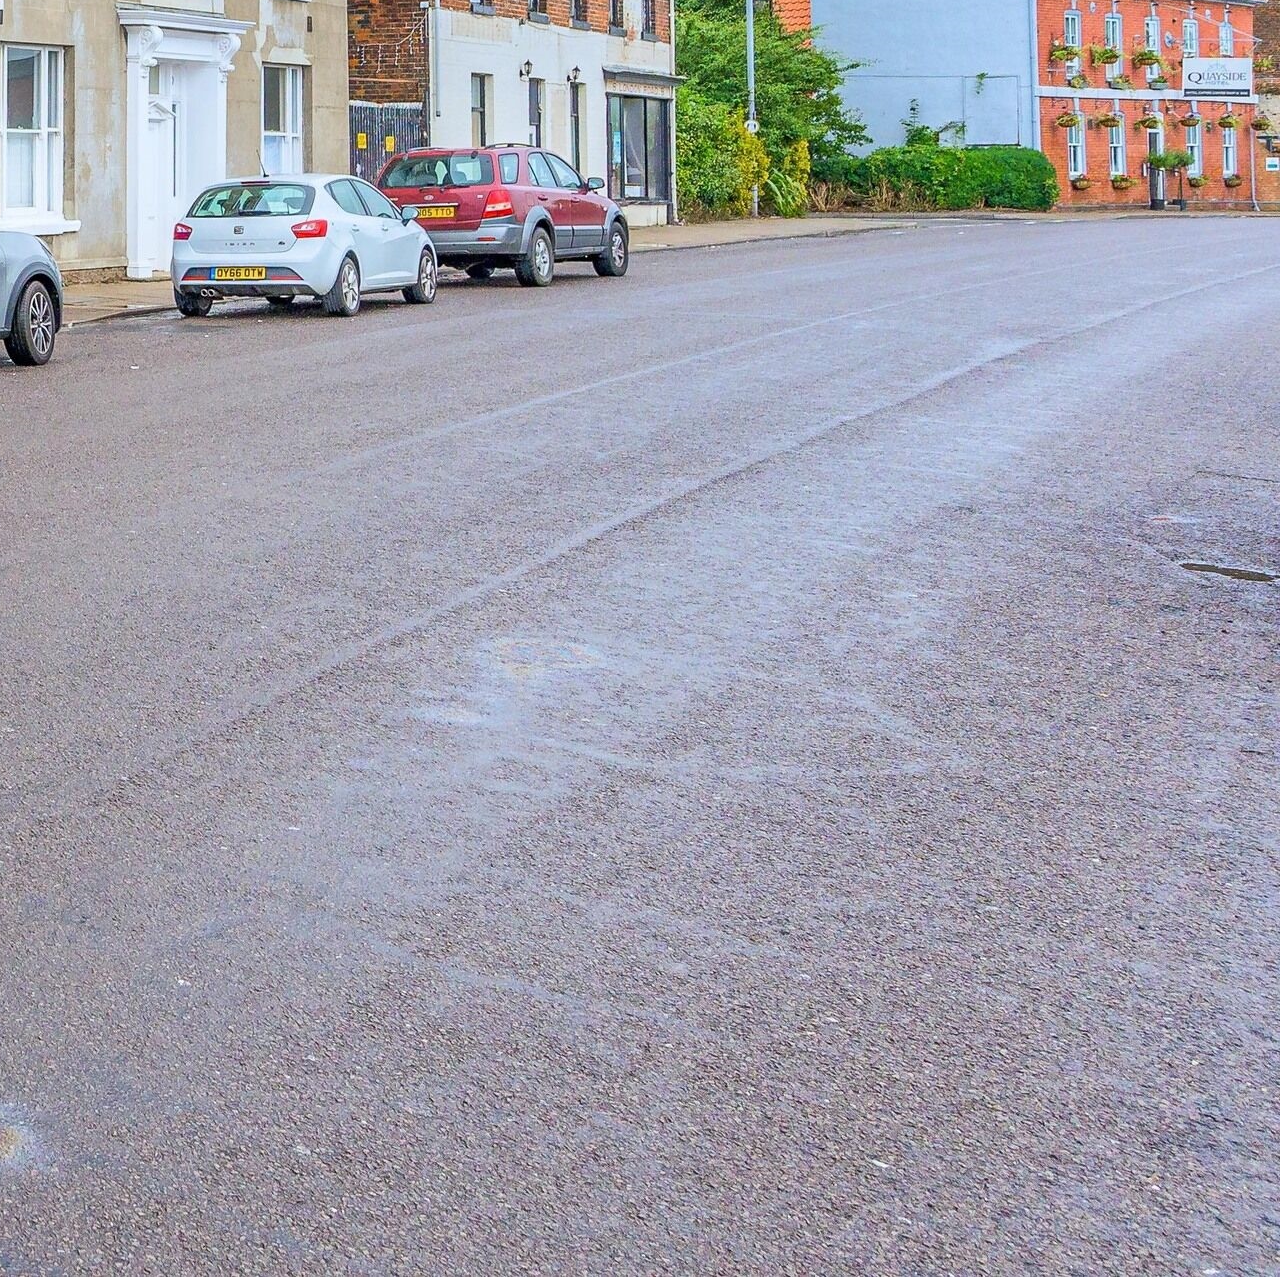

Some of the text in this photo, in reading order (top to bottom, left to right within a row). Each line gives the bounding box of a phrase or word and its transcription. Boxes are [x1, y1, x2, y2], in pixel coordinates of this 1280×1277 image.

[1188, 72, 1247, 84] QUAYSIDE
[217, 268, 264, 277] OY66 OTW
